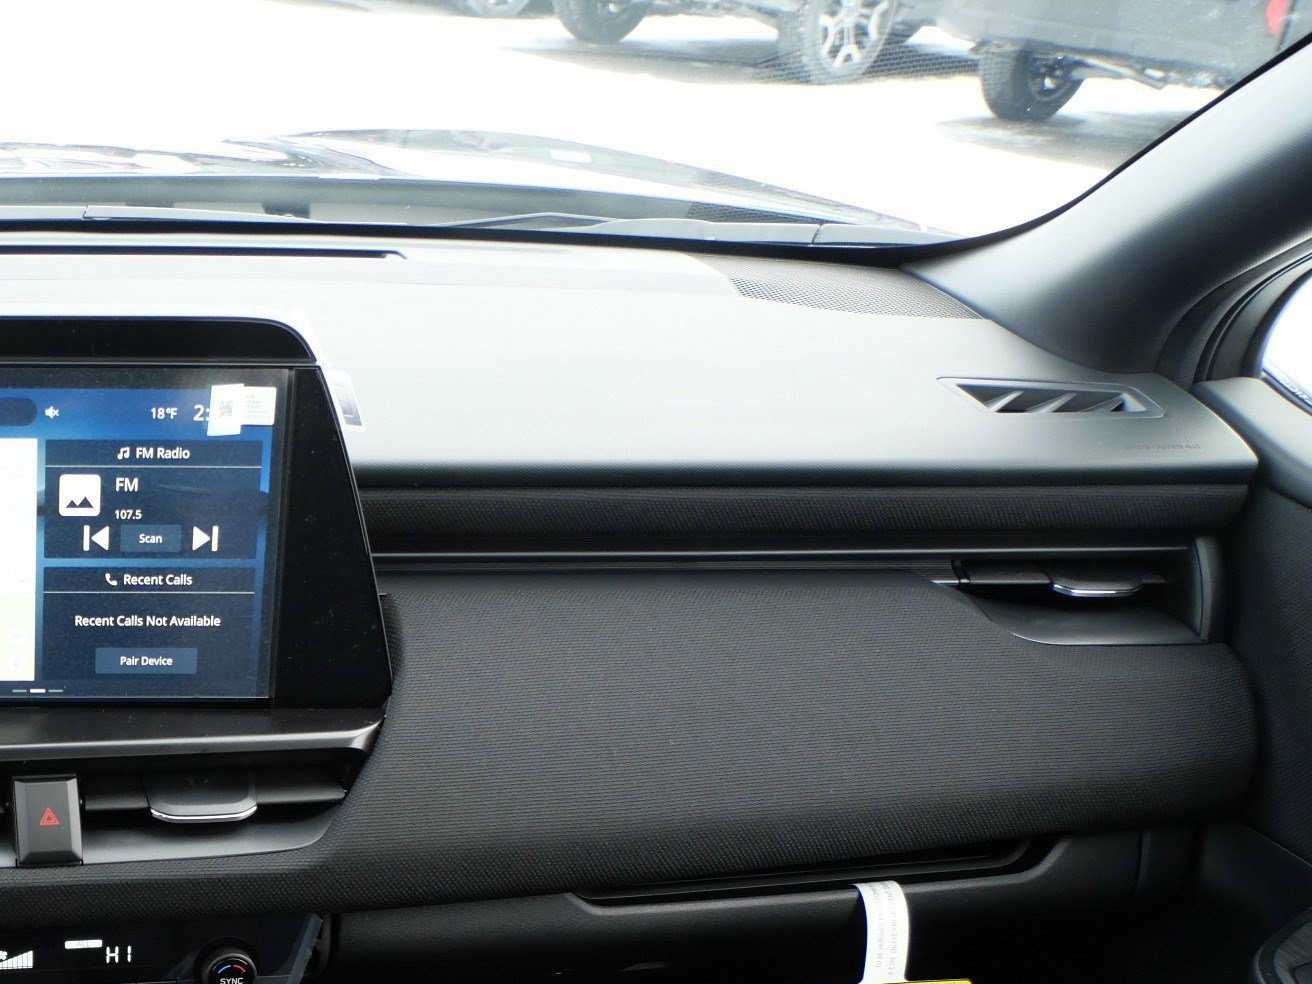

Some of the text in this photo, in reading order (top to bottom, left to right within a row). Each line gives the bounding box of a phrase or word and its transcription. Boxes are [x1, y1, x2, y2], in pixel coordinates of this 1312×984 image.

[193, 404, 210, 422] 2:
[135, 447, 190, 459] FM Radio
[115, 477, 139, 492] FM
[114, 509, 142, 520] 107.5
[139, 533, 162, 544] Scan
[123, 574, 193, 586] Recent Calls
[74, 615, 221, 627] Recent Calls Not Available
[120, 655, 173, 667] Pair Device
